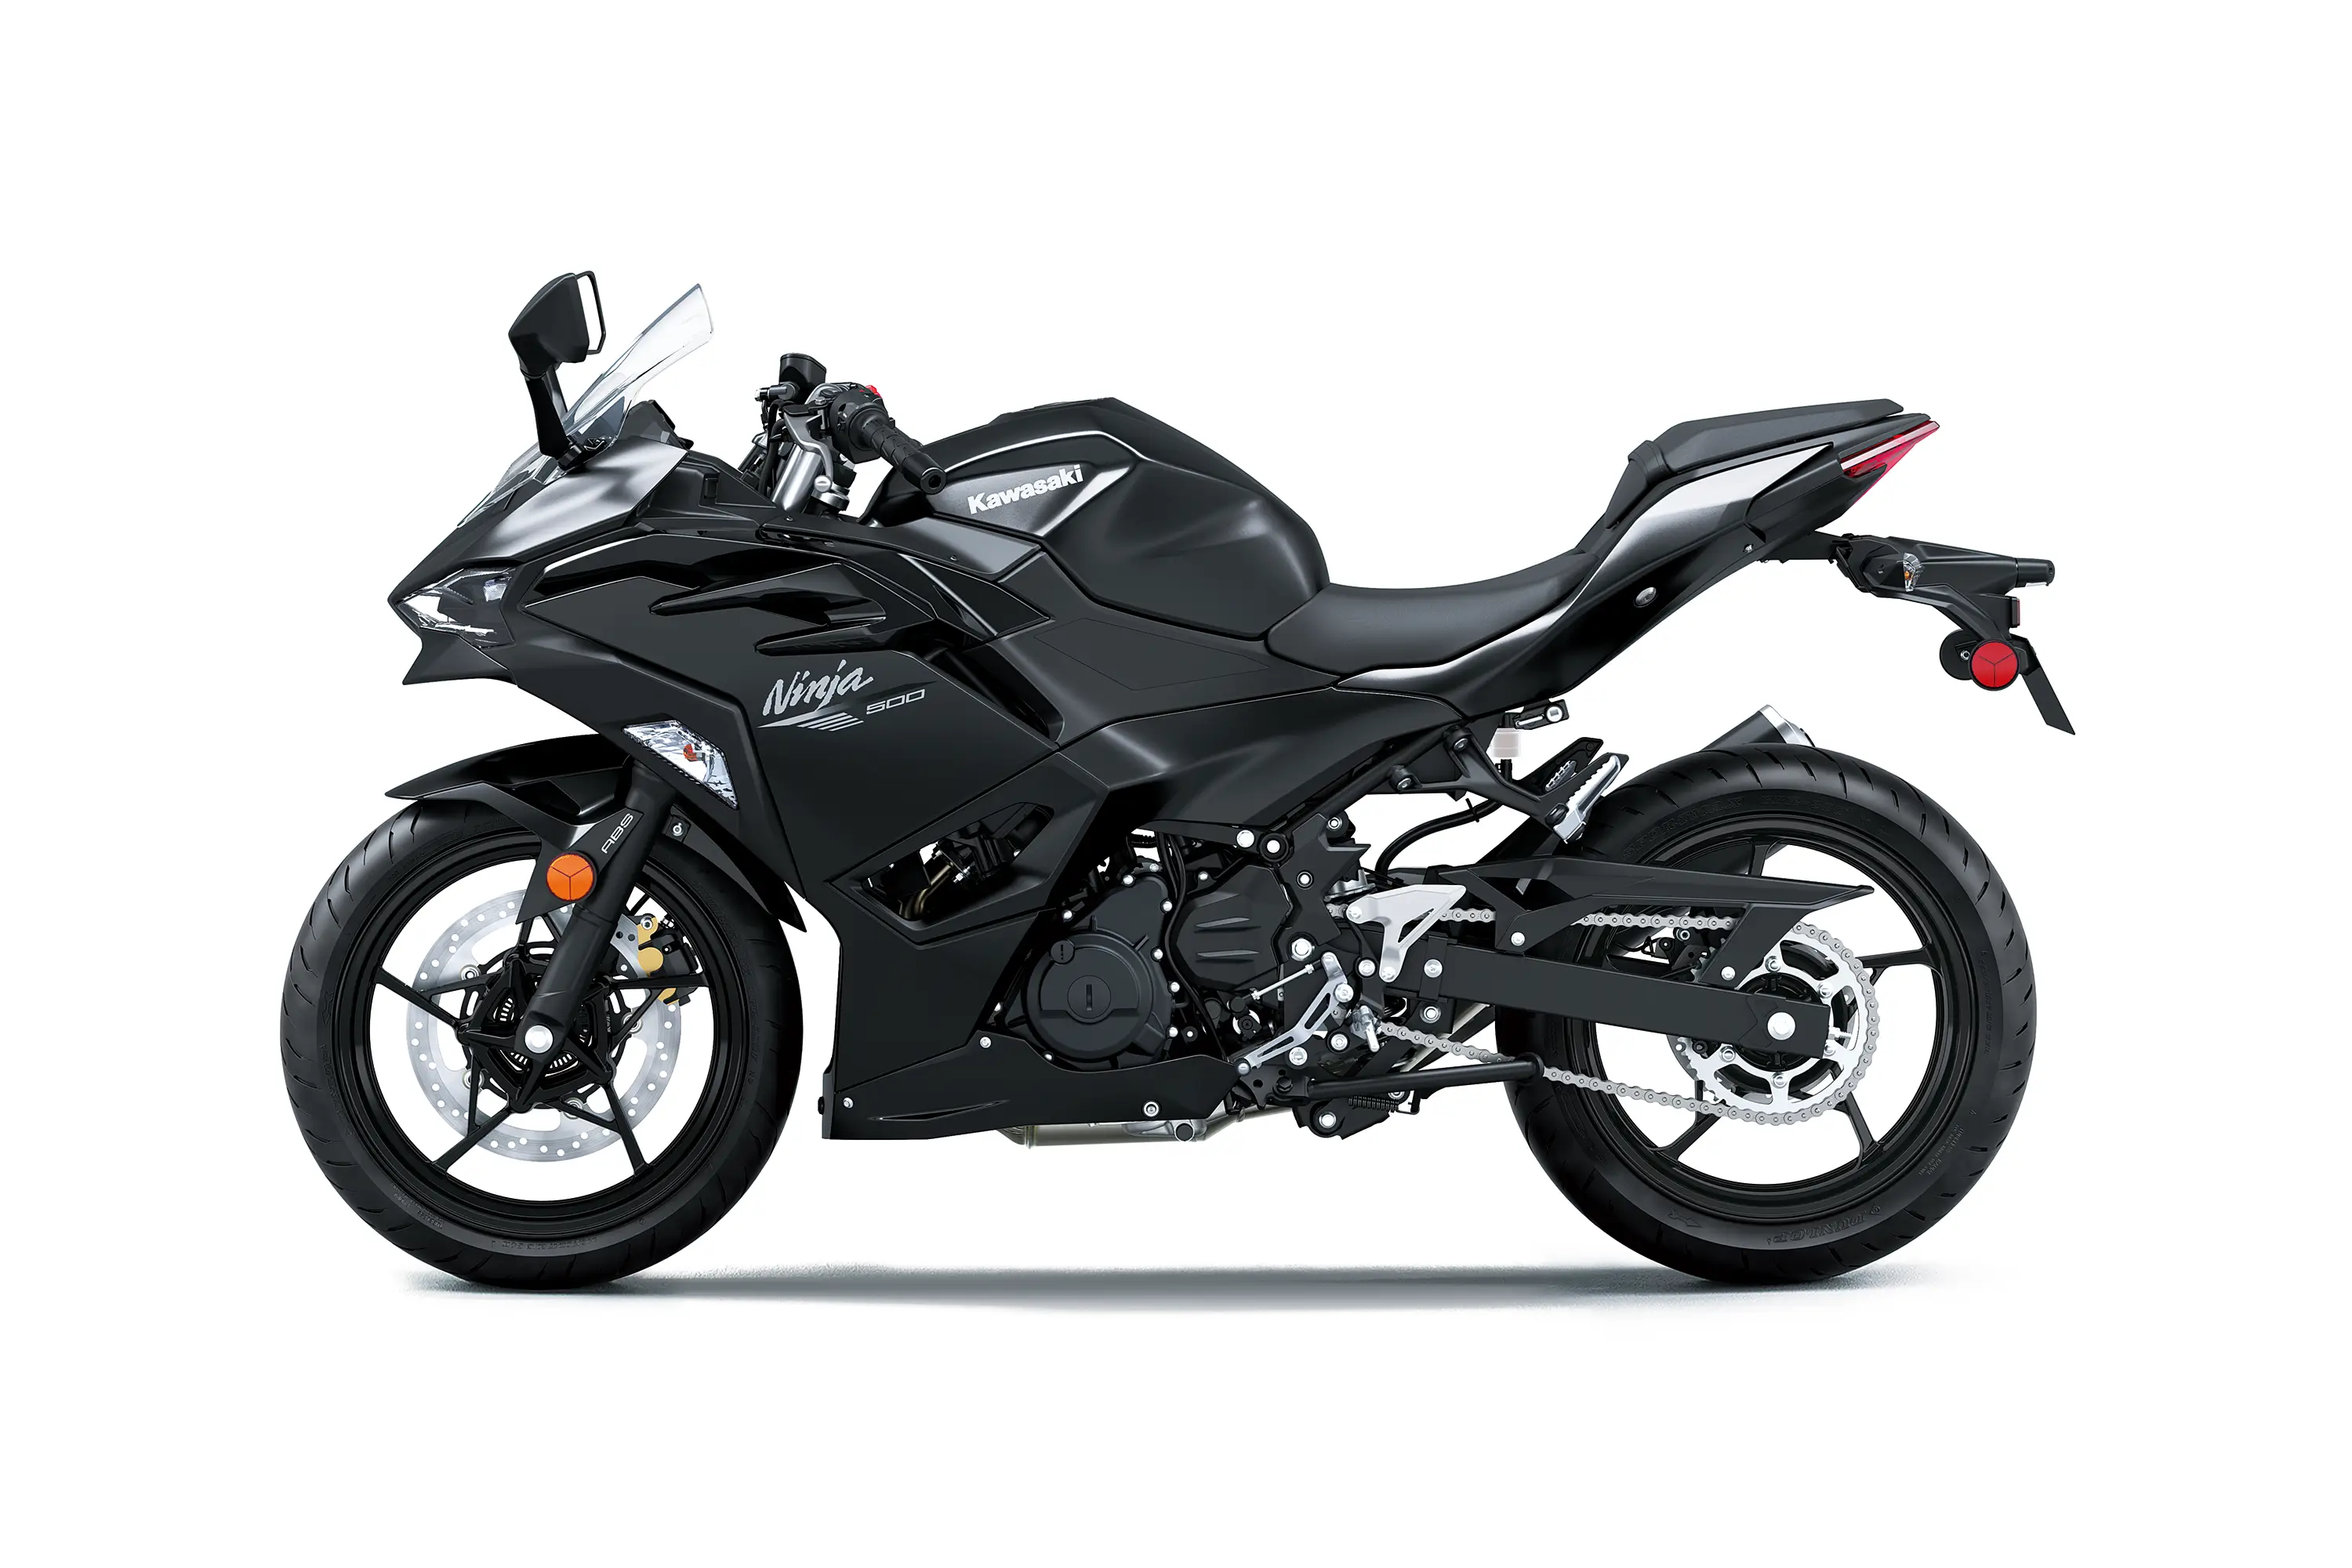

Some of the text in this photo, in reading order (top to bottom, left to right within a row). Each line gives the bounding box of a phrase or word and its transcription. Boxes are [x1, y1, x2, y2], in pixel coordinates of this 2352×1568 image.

[967, 464, 1083, 515] Kawasaki
[762, 659, 925, 716] Ninja 500
[601, 813, 633, 854] ABS
